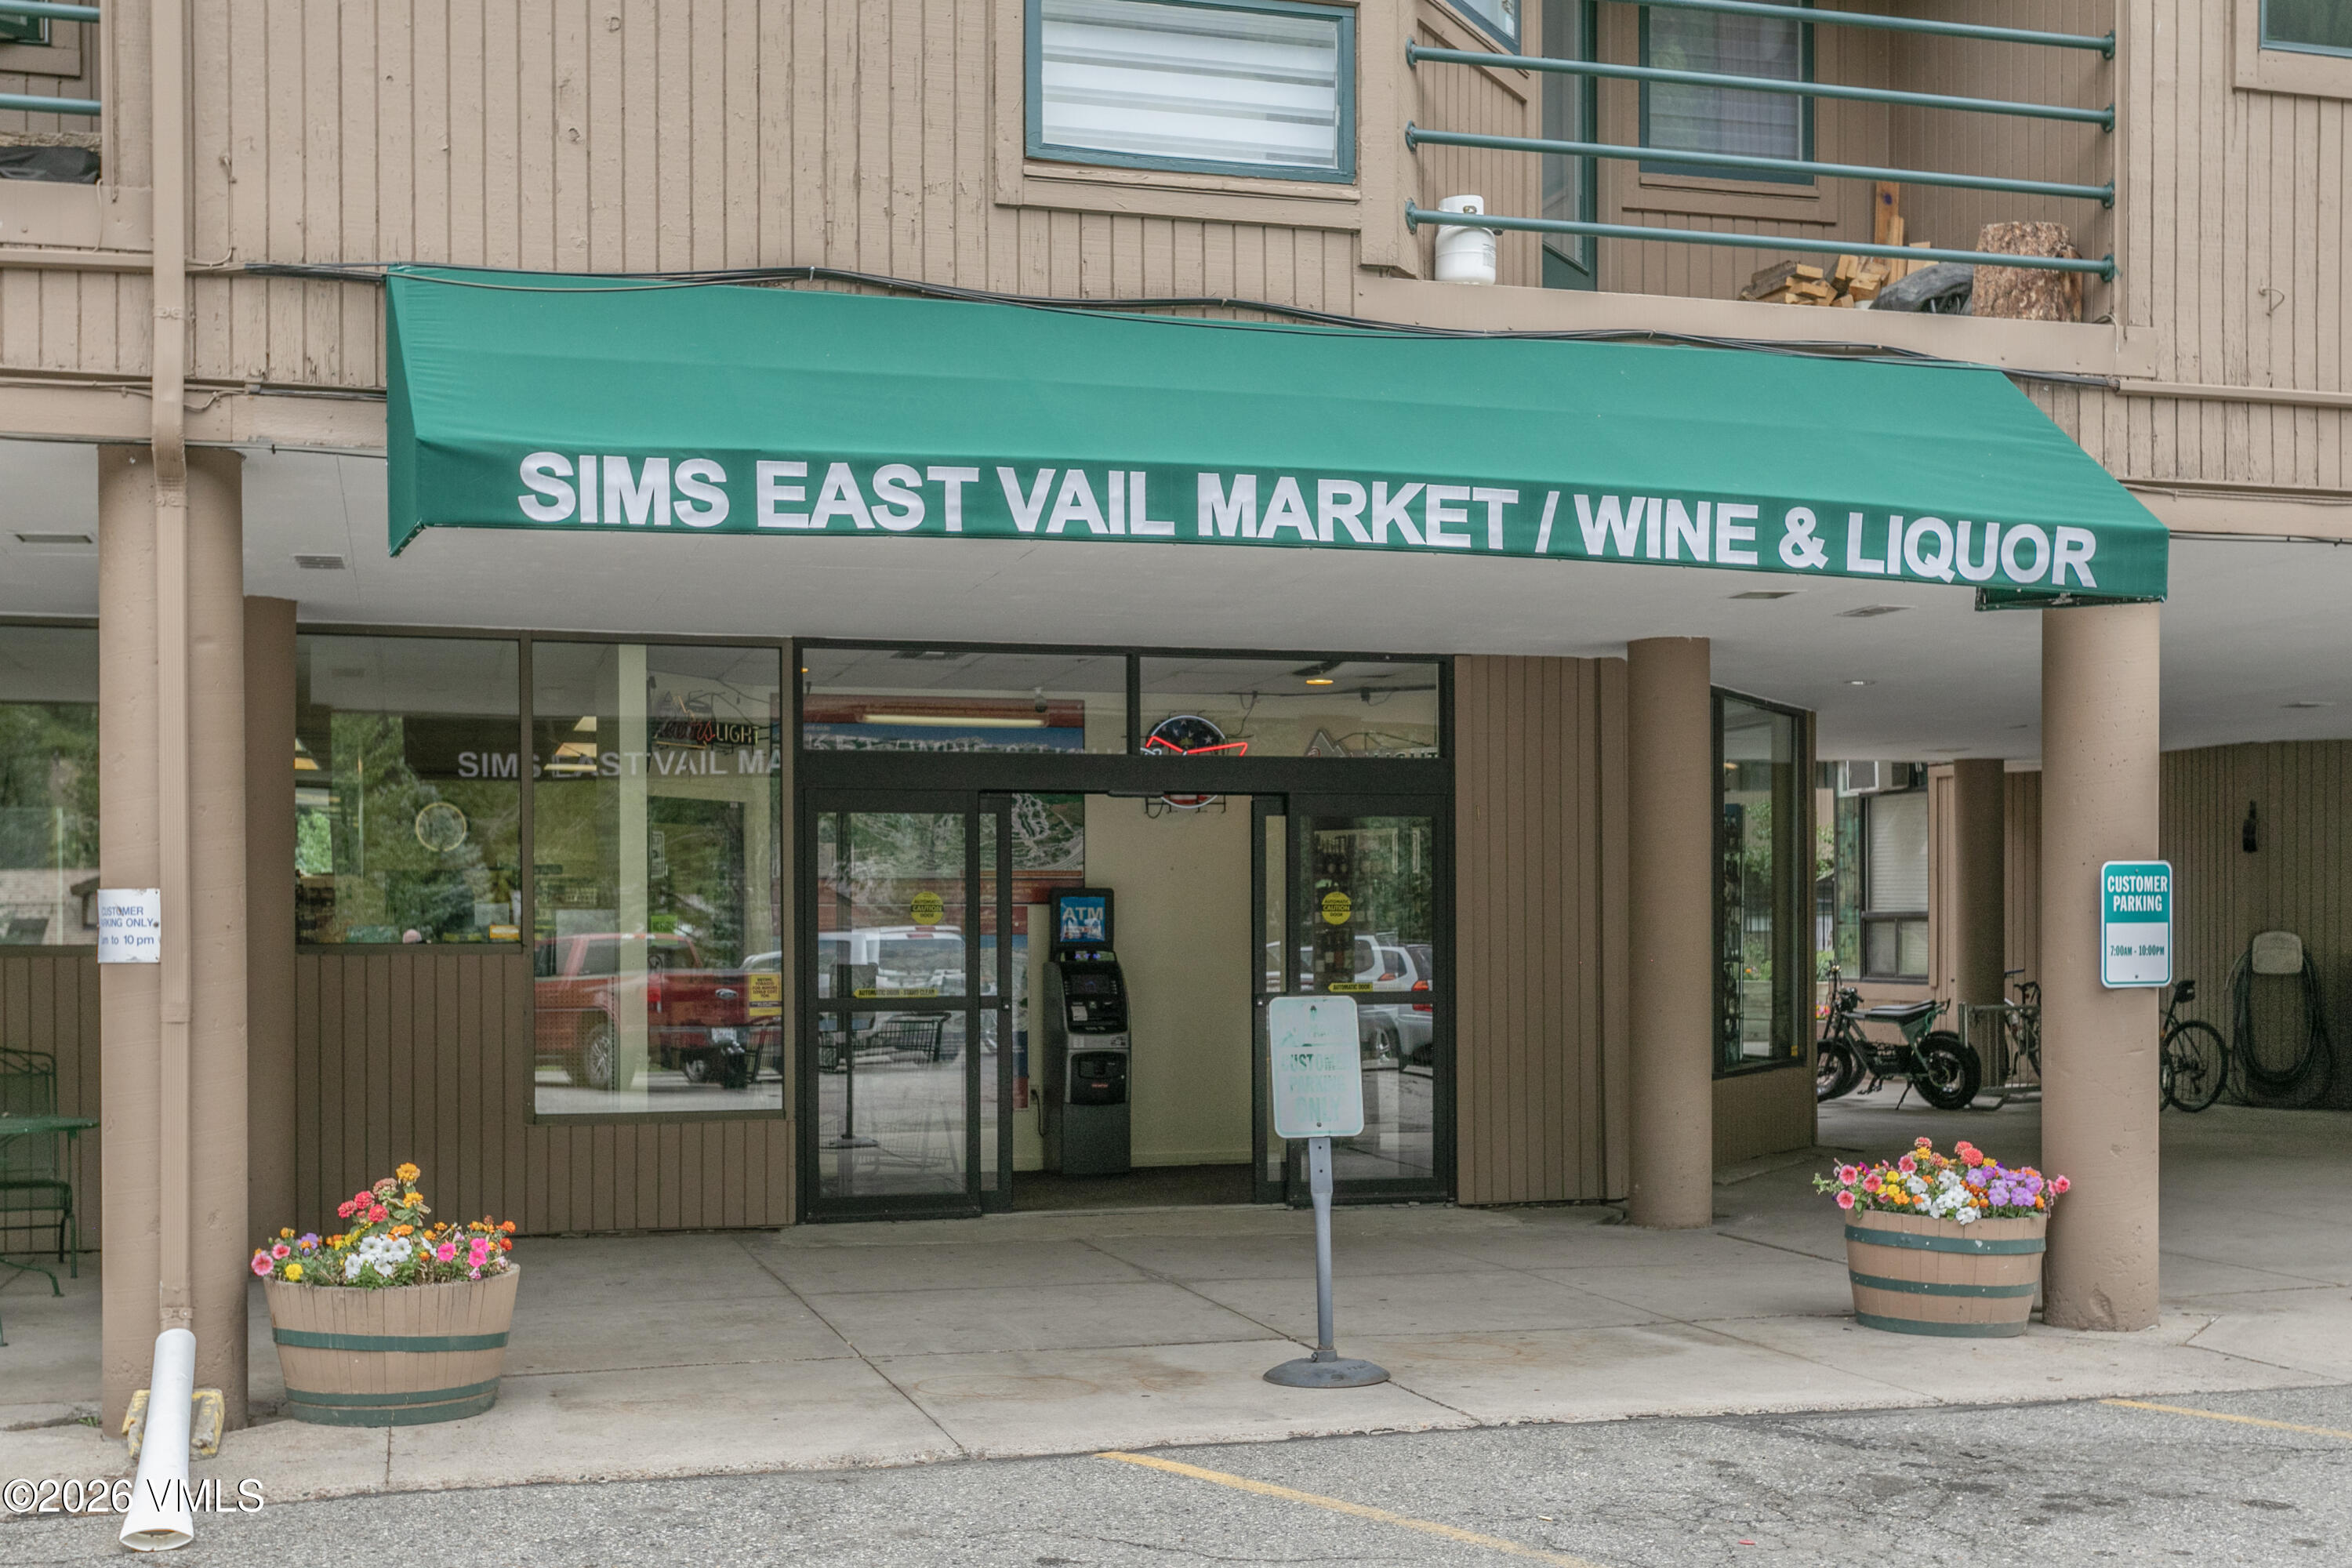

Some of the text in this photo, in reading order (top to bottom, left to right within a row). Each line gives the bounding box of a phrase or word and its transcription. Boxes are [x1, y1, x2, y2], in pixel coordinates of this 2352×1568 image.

[517, 452, 730, 528] SIMS
[756, 459, 979, 532] EAST
[996, 466, 1175, 535] VAIL
[1197, 471, 1519, 550] MARKET
[1778, 506, 1829, 570] &
[1846, 511, 2098, 588] LIQUOR
[2107, 875, 2168, 892] CUSTOMER
[2113, 895, 2162, 912] PARKING
[101, 906, 143, 916] CUSTOMER
[1062, 907, 1104, 920] ATM
[125, 917, 154, 927] ONLY
[111, 935, 119, 945] to
[124, 935, 134, 945] 10
[136, 936, 154, 946] pm
[2111, 945, 2132, 956] 7:00AM
[2139, 945, 2165, 956] 10:00PM
